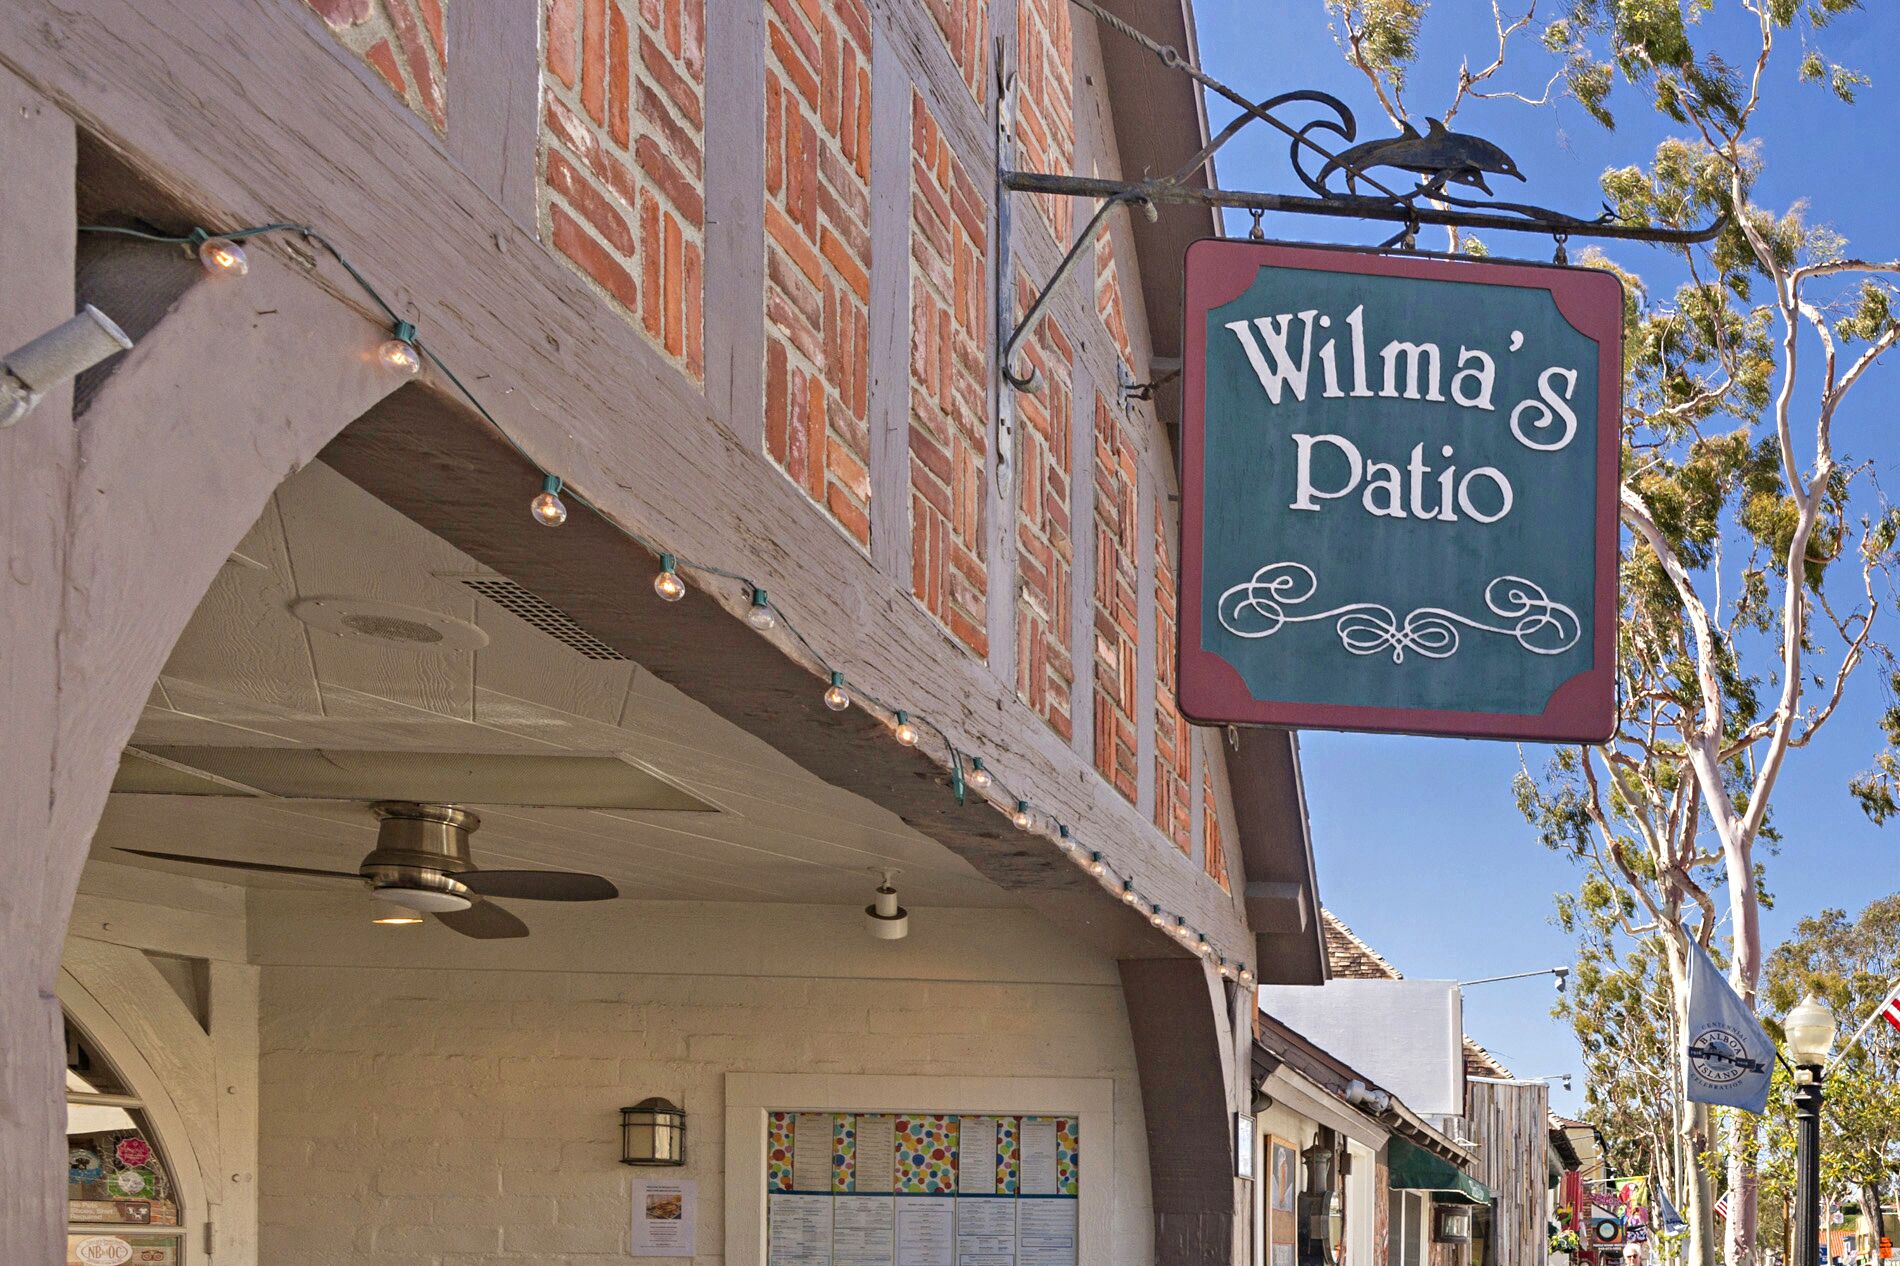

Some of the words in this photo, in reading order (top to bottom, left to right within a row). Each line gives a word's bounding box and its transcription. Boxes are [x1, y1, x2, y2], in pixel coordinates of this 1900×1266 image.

[1224, 304, 1578, 452] Wilma's
[1288, 432, 1514, 525] Patio
[1700, 1033, 1742, 1055] BALBOA
[1691, 1073, 1743, 1091] CELEBRATION
[1698, 1063, 1739, 1079] ISLAND
